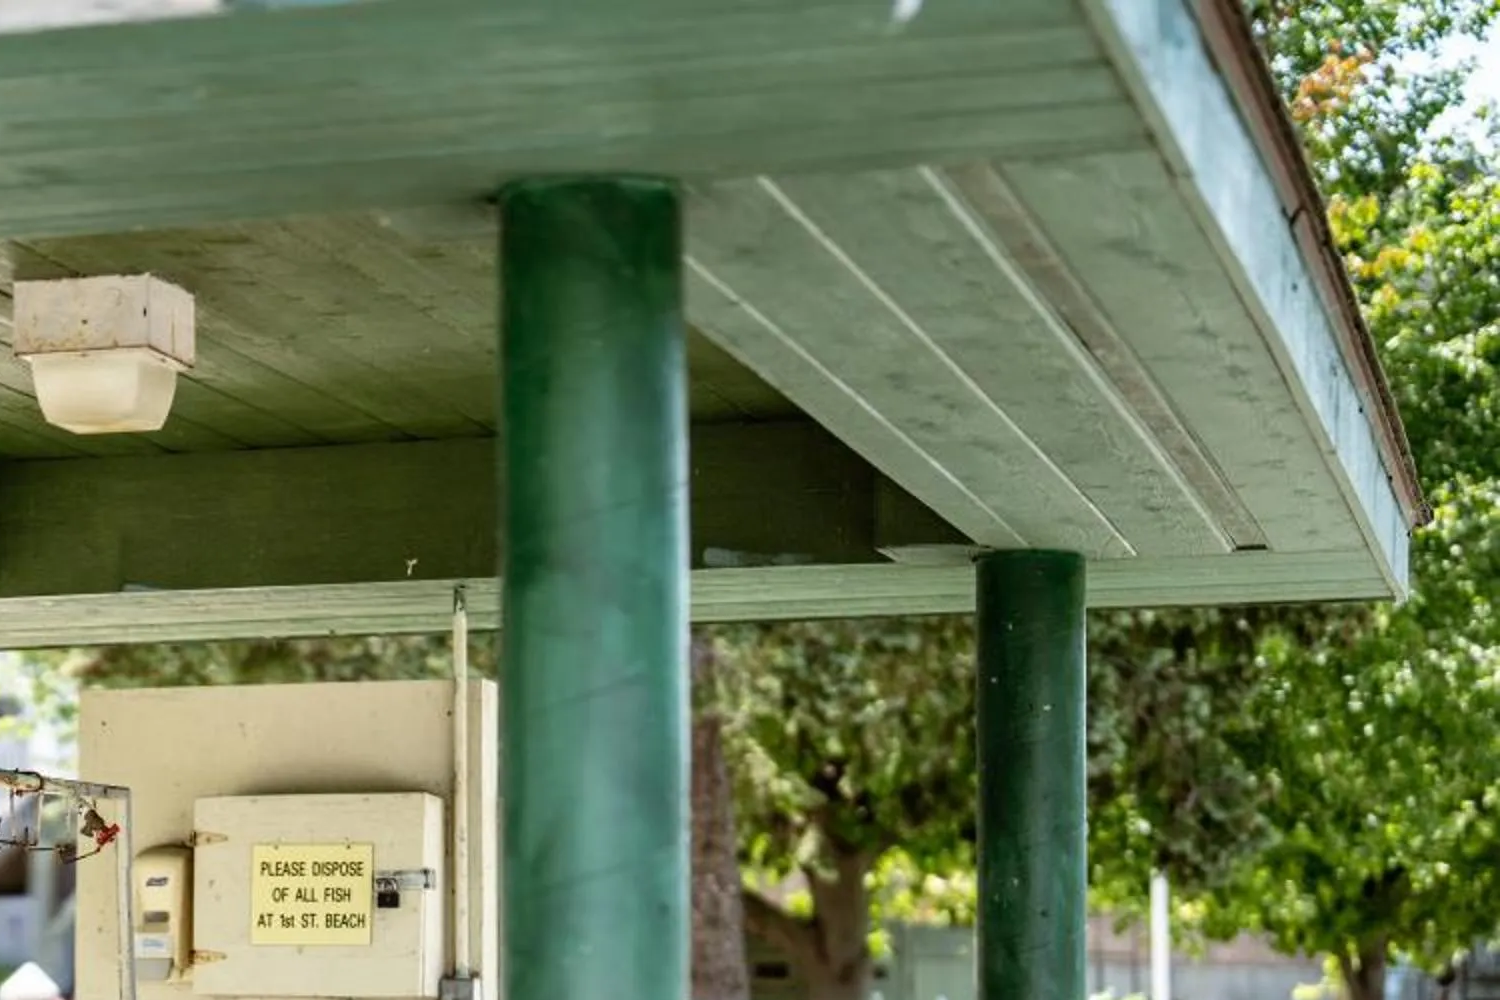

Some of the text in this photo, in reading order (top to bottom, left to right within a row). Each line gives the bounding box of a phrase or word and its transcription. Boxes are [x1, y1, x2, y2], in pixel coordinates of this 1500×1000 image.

[260, 861, 364, 877] PLEASE DISPOSE
[273, 887, 351, 902] OF ALL FISH
[257, 913, 366, 928] AT 1st ST. BEACH
